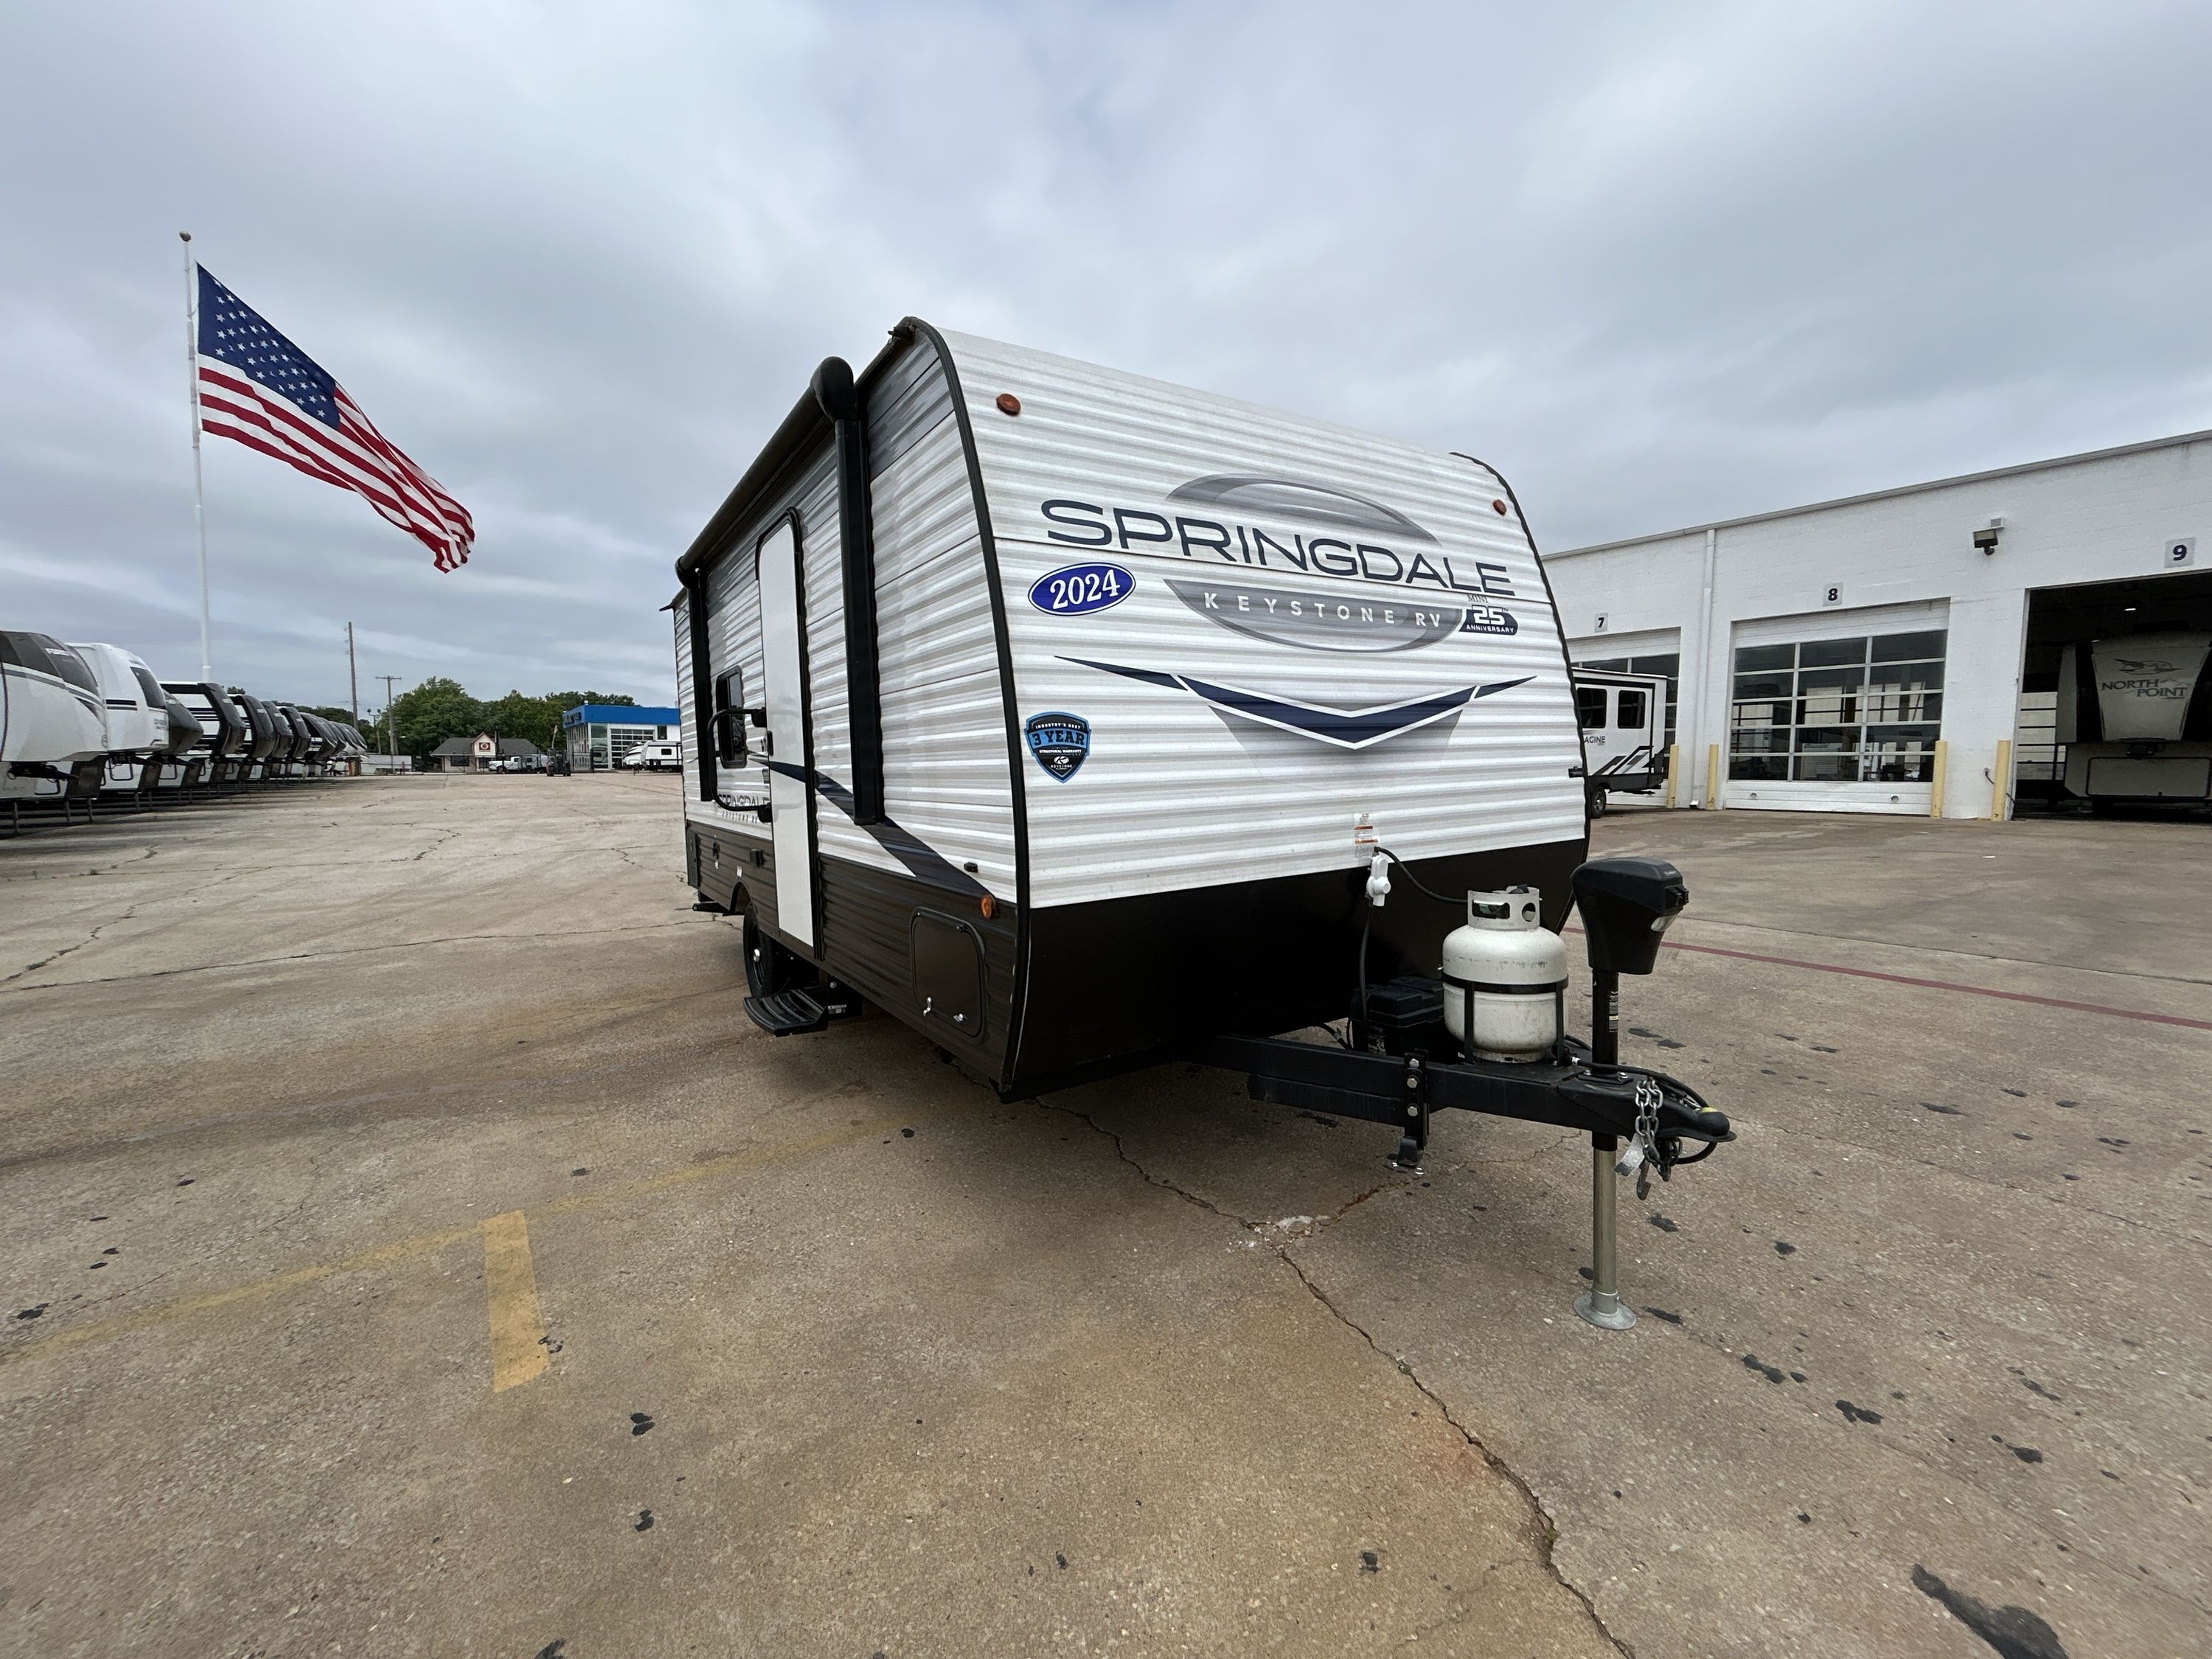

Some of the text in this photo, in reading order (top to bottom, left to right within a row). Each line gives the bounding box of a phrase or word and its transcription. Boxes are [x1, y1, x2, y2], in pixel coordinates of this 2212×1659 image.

[1040, 499, 1515, 597] SPRINGDALE
[2173, 544, 2187, 561] 9
[1049, 568, 1121, 611] 2024
[1828, 588, 1838, 602] 8
[1203, 591, 1441, 627] KEYSTONE RV
[1466, 624, 1514, 634] ANNIVERSARY
[1598, 616, 1604, 628] 7
[2101, 678, 2160, 691] NORTH
[2137, 686, 2188, 698] POINT
[1032, 730, 1085, 746] 3 YEAR
